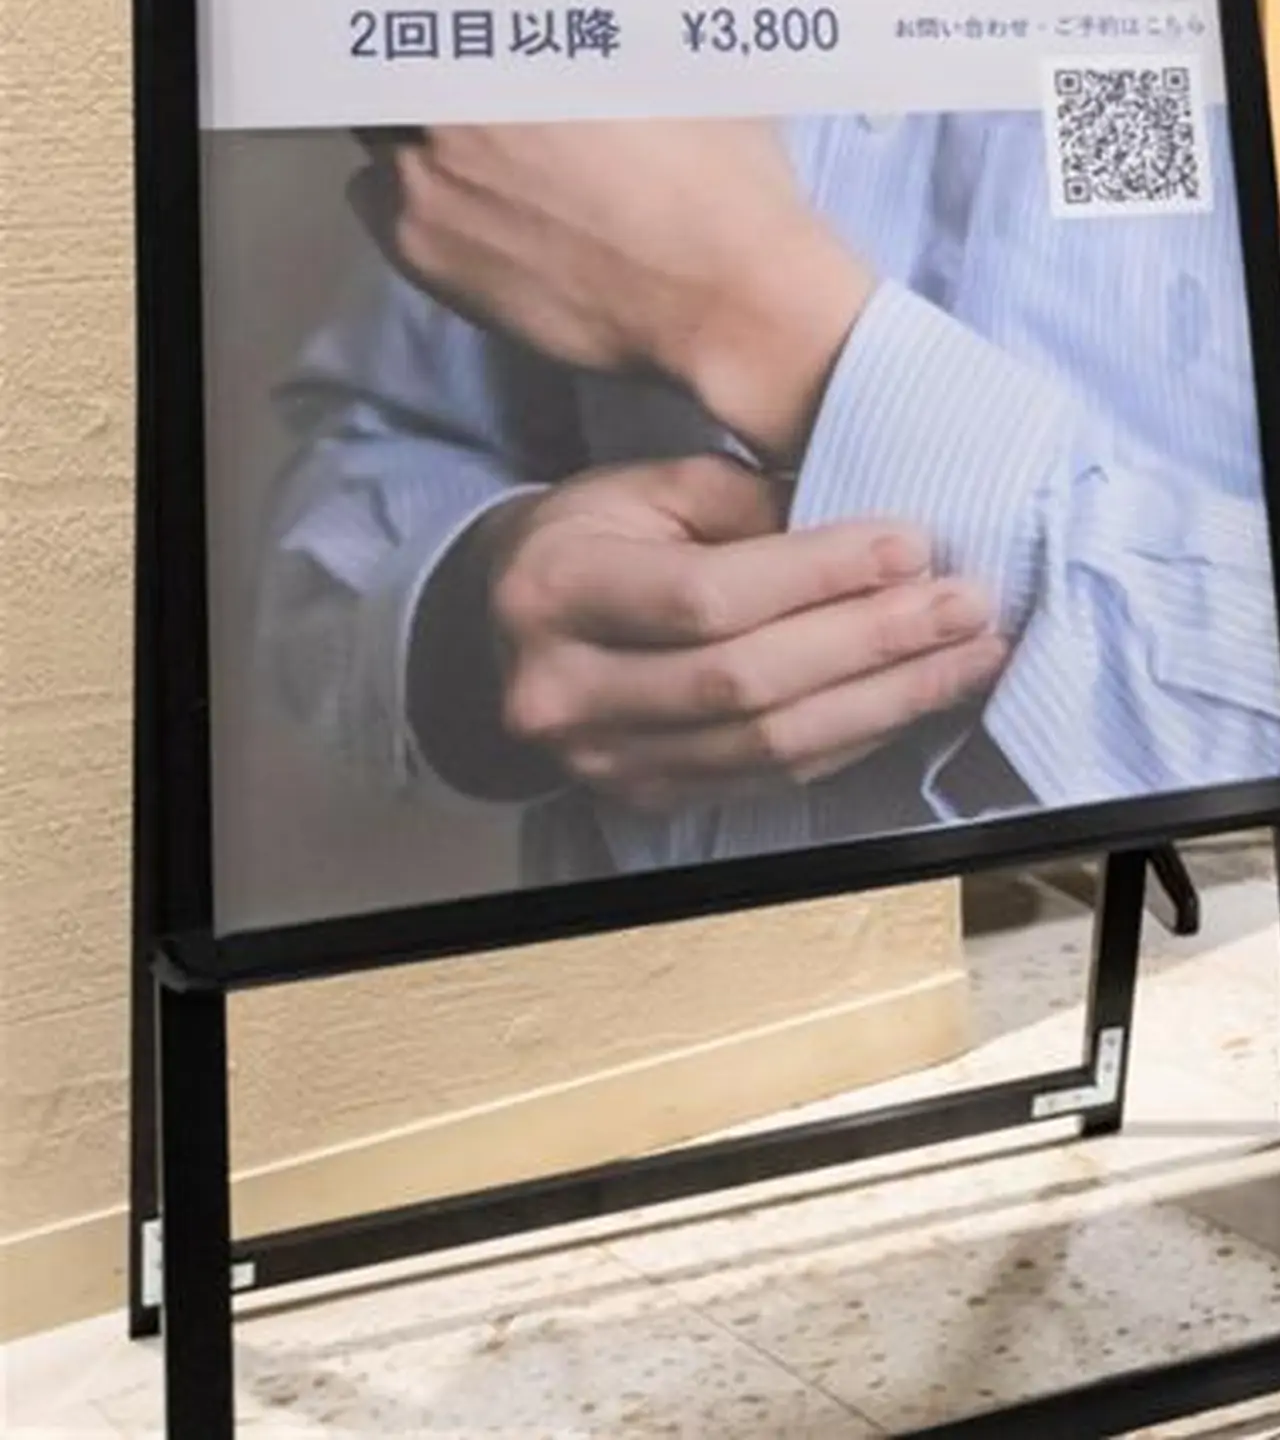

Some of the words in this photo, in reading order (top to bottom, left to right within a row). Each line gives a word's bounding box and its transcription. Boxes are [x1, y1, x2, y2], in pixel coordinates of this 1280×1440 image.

[349, 8, 622, 60] 2回目以降
[681, 6, 840, 56] ¥3,800
